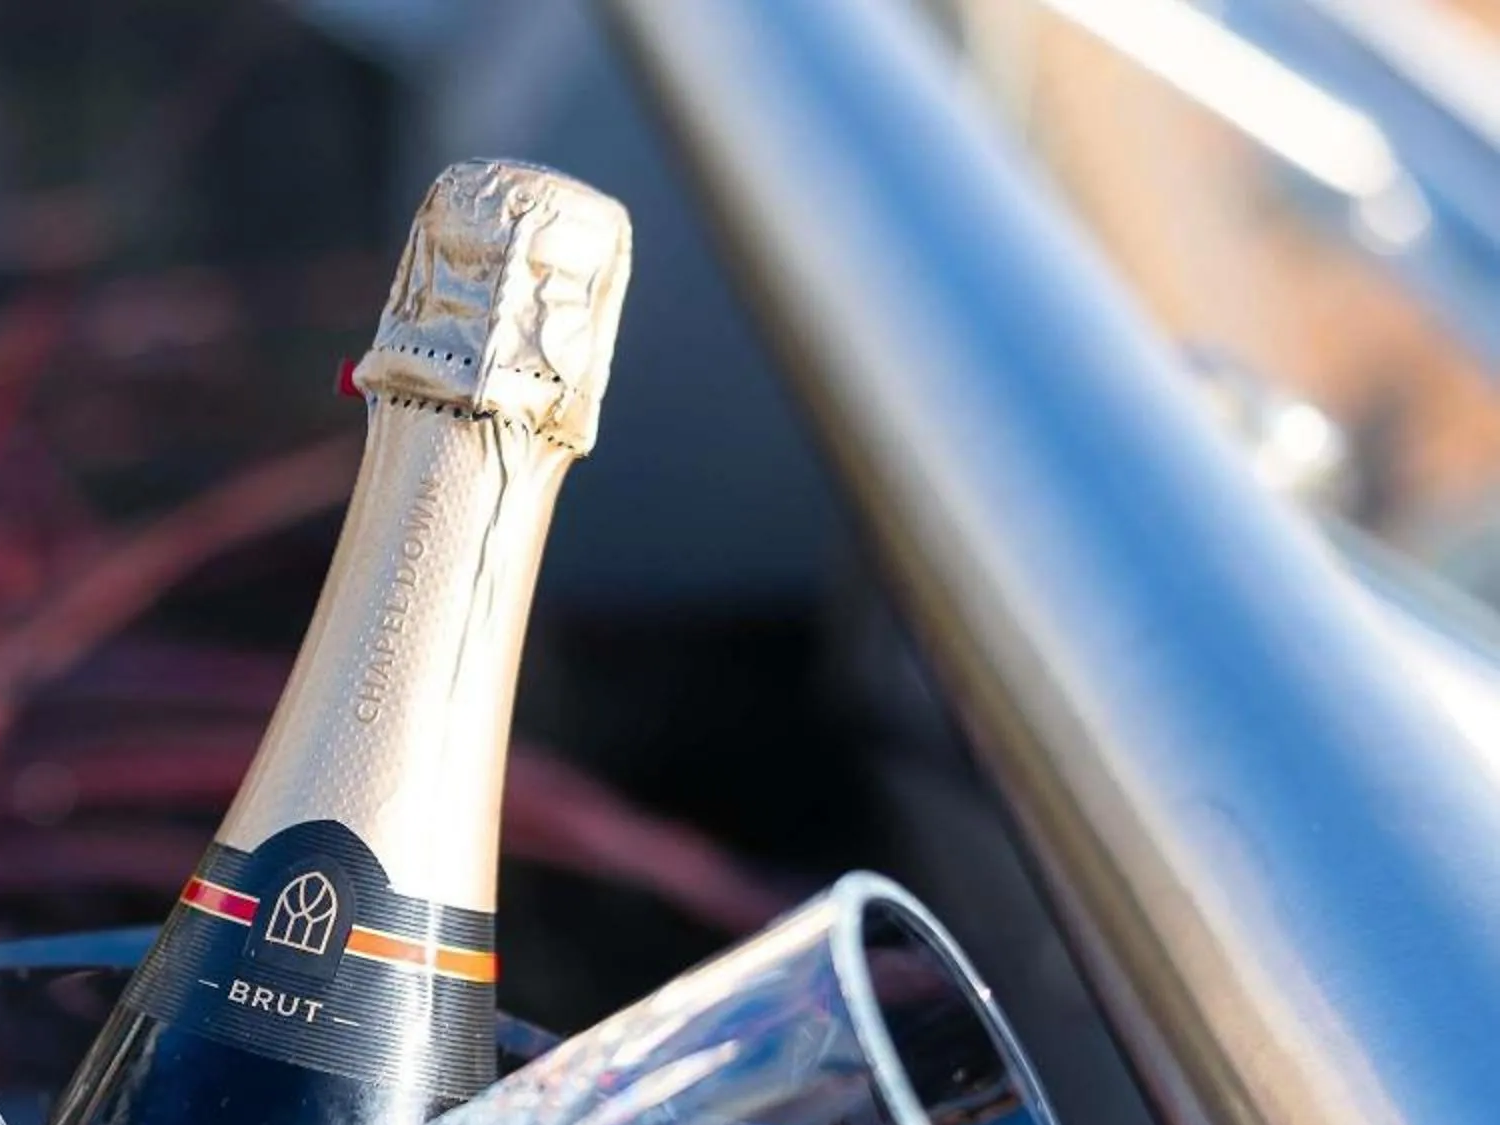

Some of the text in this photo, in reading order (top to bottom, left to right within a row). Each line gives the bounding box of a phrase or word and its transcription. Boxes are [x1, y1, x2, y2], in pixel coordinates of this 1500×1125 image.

[356, 478, 442, 724] CHAPEL DOWN
[227, 978, 324, 1024] BRUT
